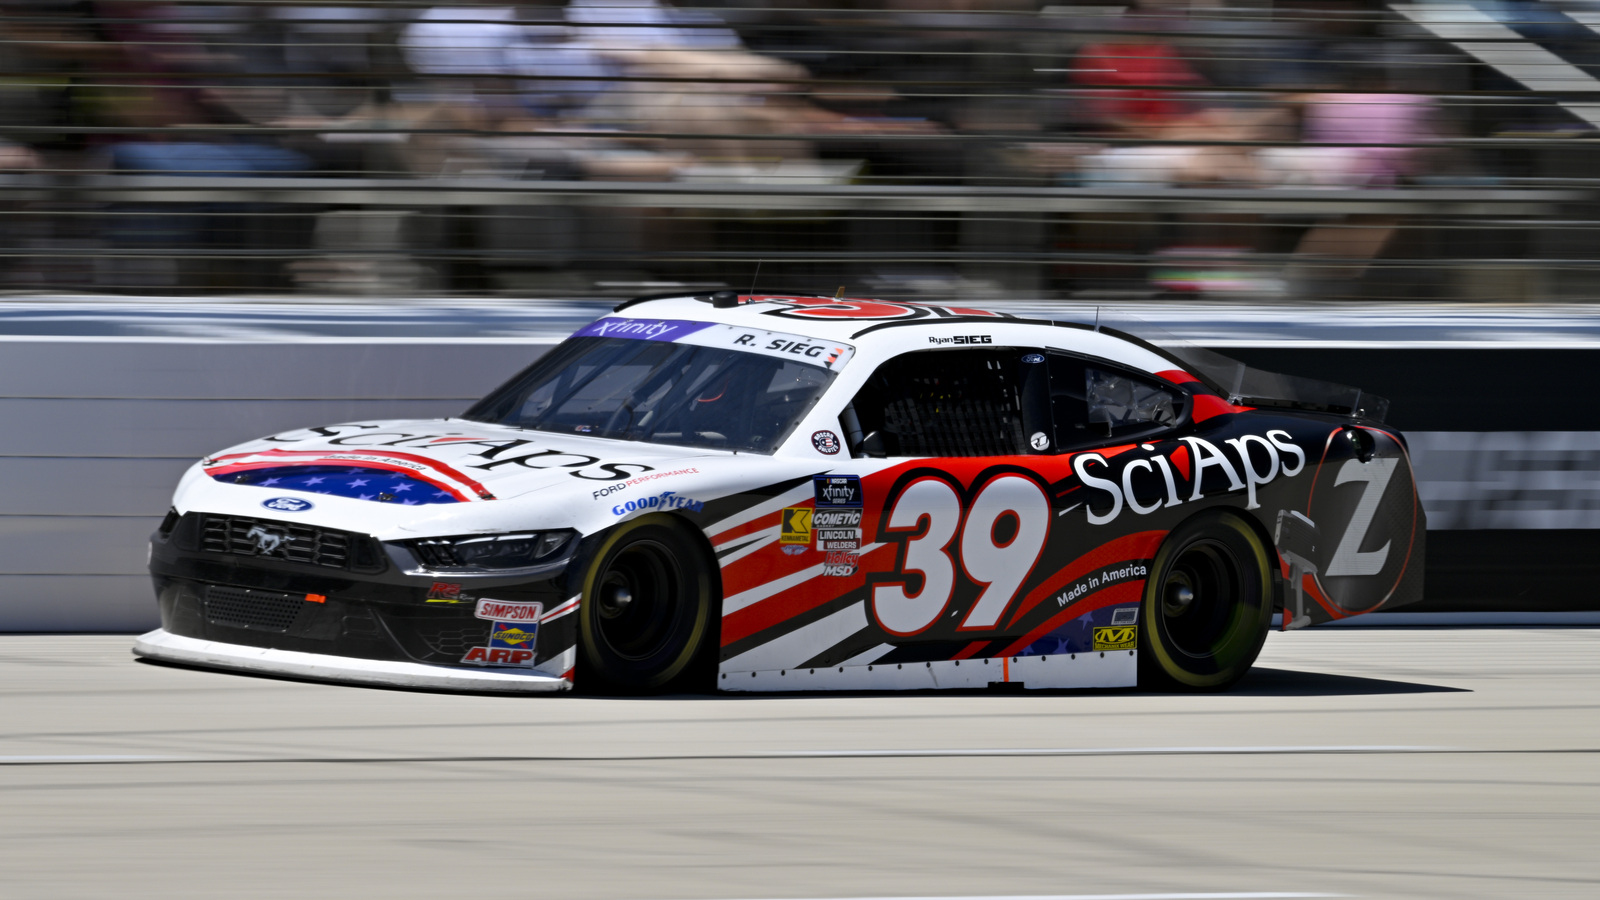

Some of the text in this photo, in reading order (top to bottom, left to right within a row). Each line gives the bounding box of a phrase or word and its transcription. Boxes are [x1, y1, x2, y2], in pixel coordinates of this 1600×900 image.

[596, 319, 678, 340] xfinity
[733, 333, 826, 358] R. SIEG
[822, 484, 855, 501] xfinity
[268, 497, 306, 511] Ford
[813, 511, 861, 525] COMETIC
[819, 530, 854, 540] LINCOLN
[826, 541, 857, 549] WELDERS
[825, 552, 860, 566] Holley
[872, 472, 1052, 637] 39
[823, 565, 853, 577] MSD
[1057, 564, 1147, 607] Made in America
[481, 602, 538, 619] SIMPSON
[494, 631, 535, 642] SUNOCO
[1120, 640, 1135, 649] WEAR
[464, 648, 534, 664] ARP
